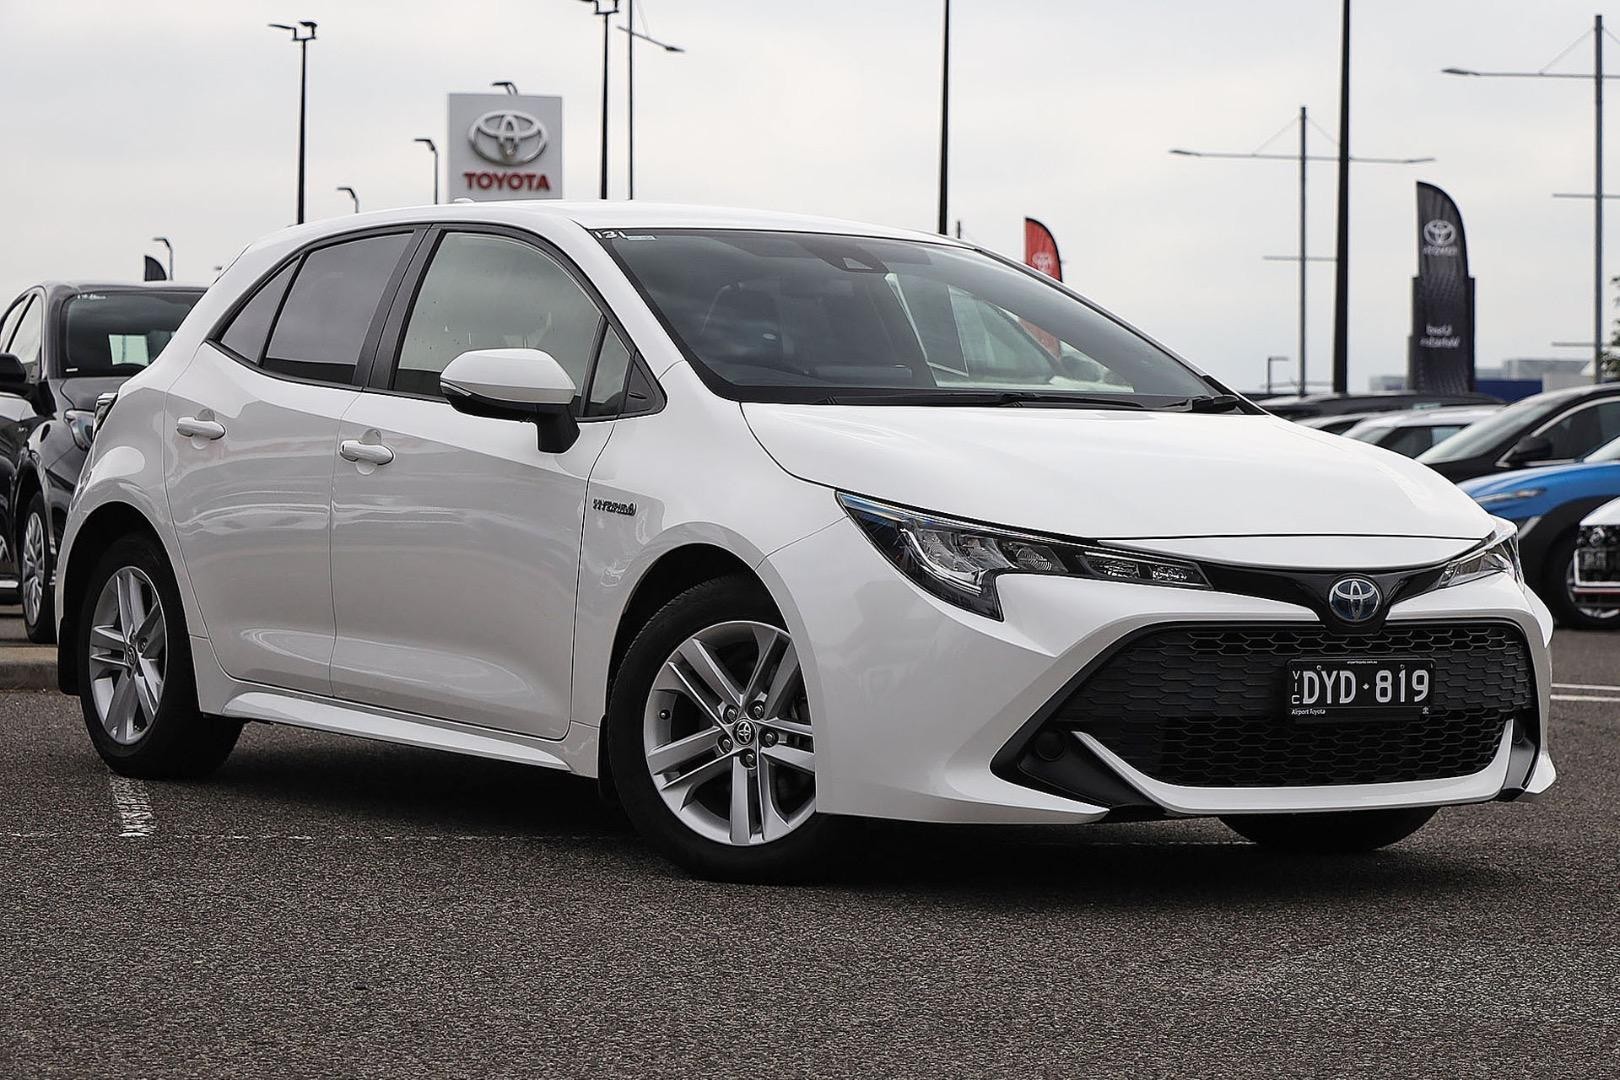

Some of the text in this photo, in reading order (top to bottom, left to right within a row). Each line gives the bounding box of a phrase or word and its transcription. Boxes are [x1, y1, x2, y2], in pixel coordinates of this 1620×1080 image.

[463, 172, 550, 191] TOYOTA
[1302, 669, 1429, 704] DYD 819
